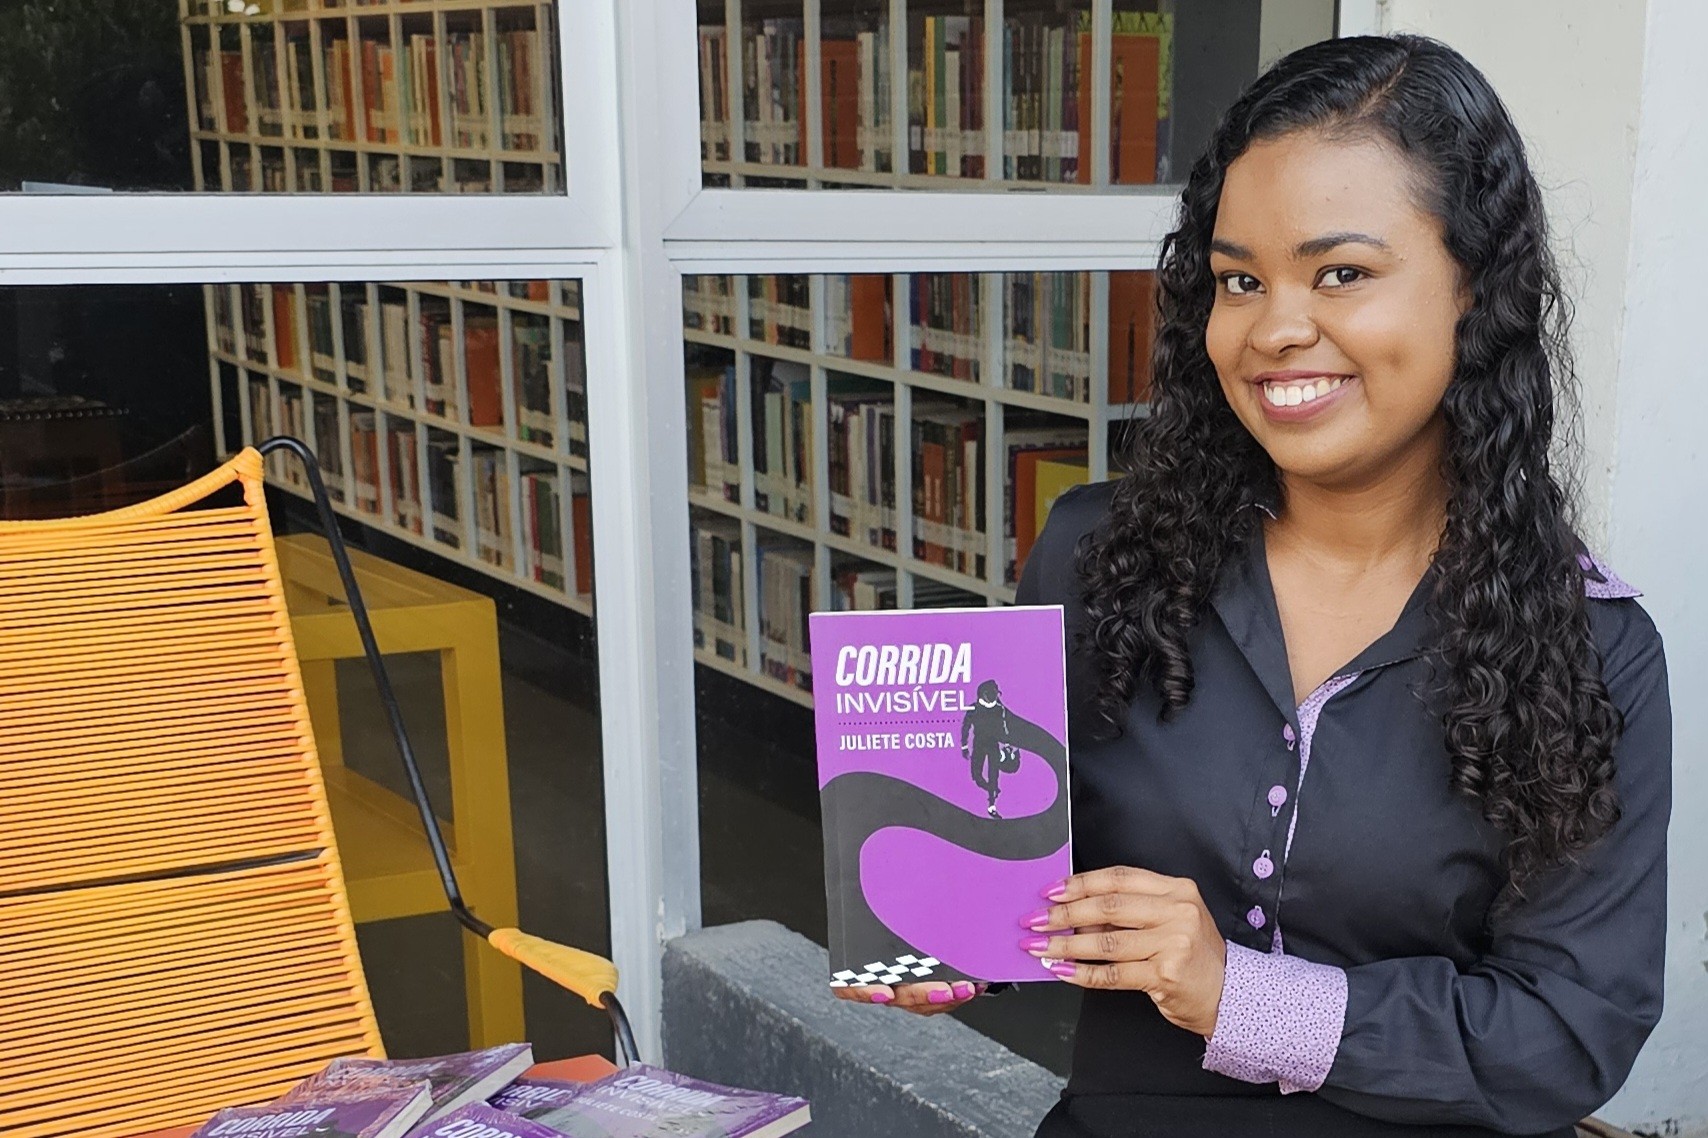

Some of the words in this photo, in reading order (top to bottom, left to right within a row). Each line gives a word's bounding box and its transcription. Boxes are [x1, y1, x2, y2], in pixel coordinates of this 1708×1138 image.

[835, 642, 972, 687] CORRIDA
[836, 685, 976, 714] INVISÍVEL
[839, 733, 901, 751] JULIETE
[904, 732, 955, 749] COSTA
[207, 1107, 337, 1137] CORRIDA
